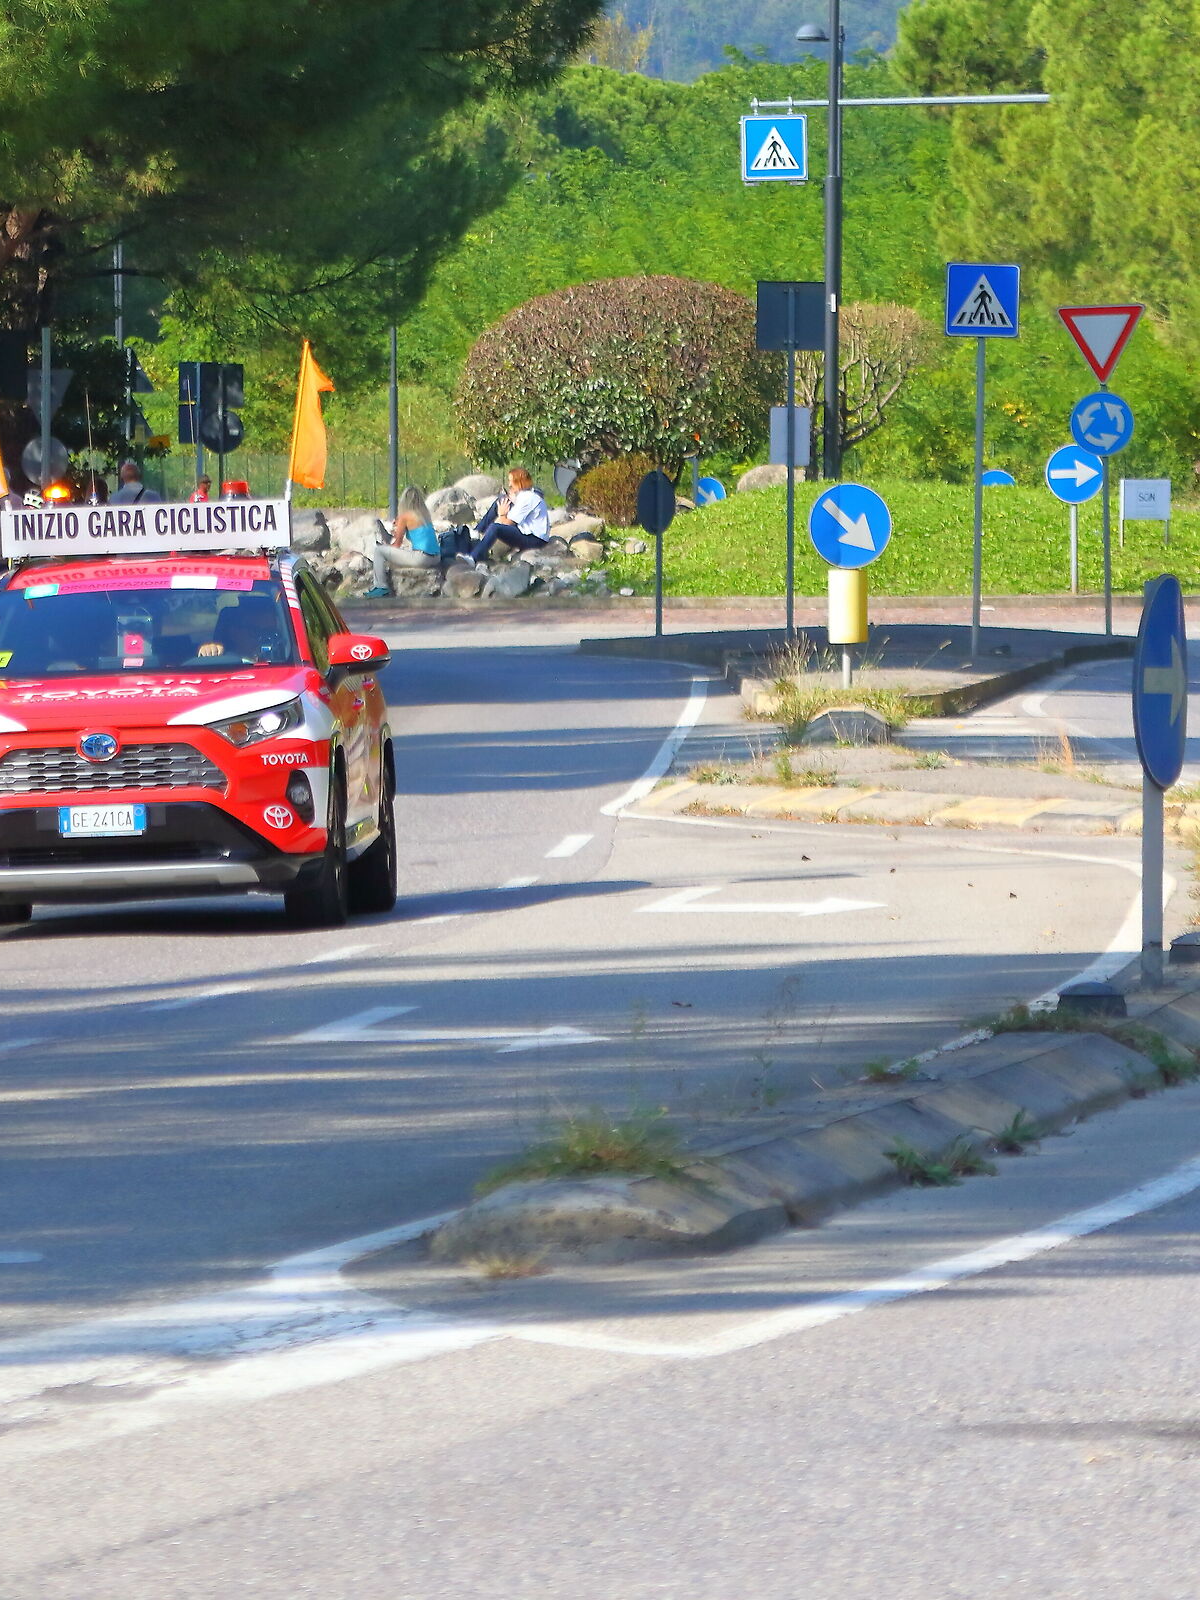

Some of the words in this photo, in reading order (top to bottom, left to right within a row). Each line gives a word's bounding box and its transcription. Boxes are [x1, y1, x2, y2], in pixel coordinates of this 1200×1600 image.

[13, 512, 79, 541] INIZIO
[88, 510, 147, 539] GARA
[155, 504, 277, 536] CICLISTICA
[17, 686, 199, 700] TOYOTA
[261, 752, 309, 766] TOYOTA
